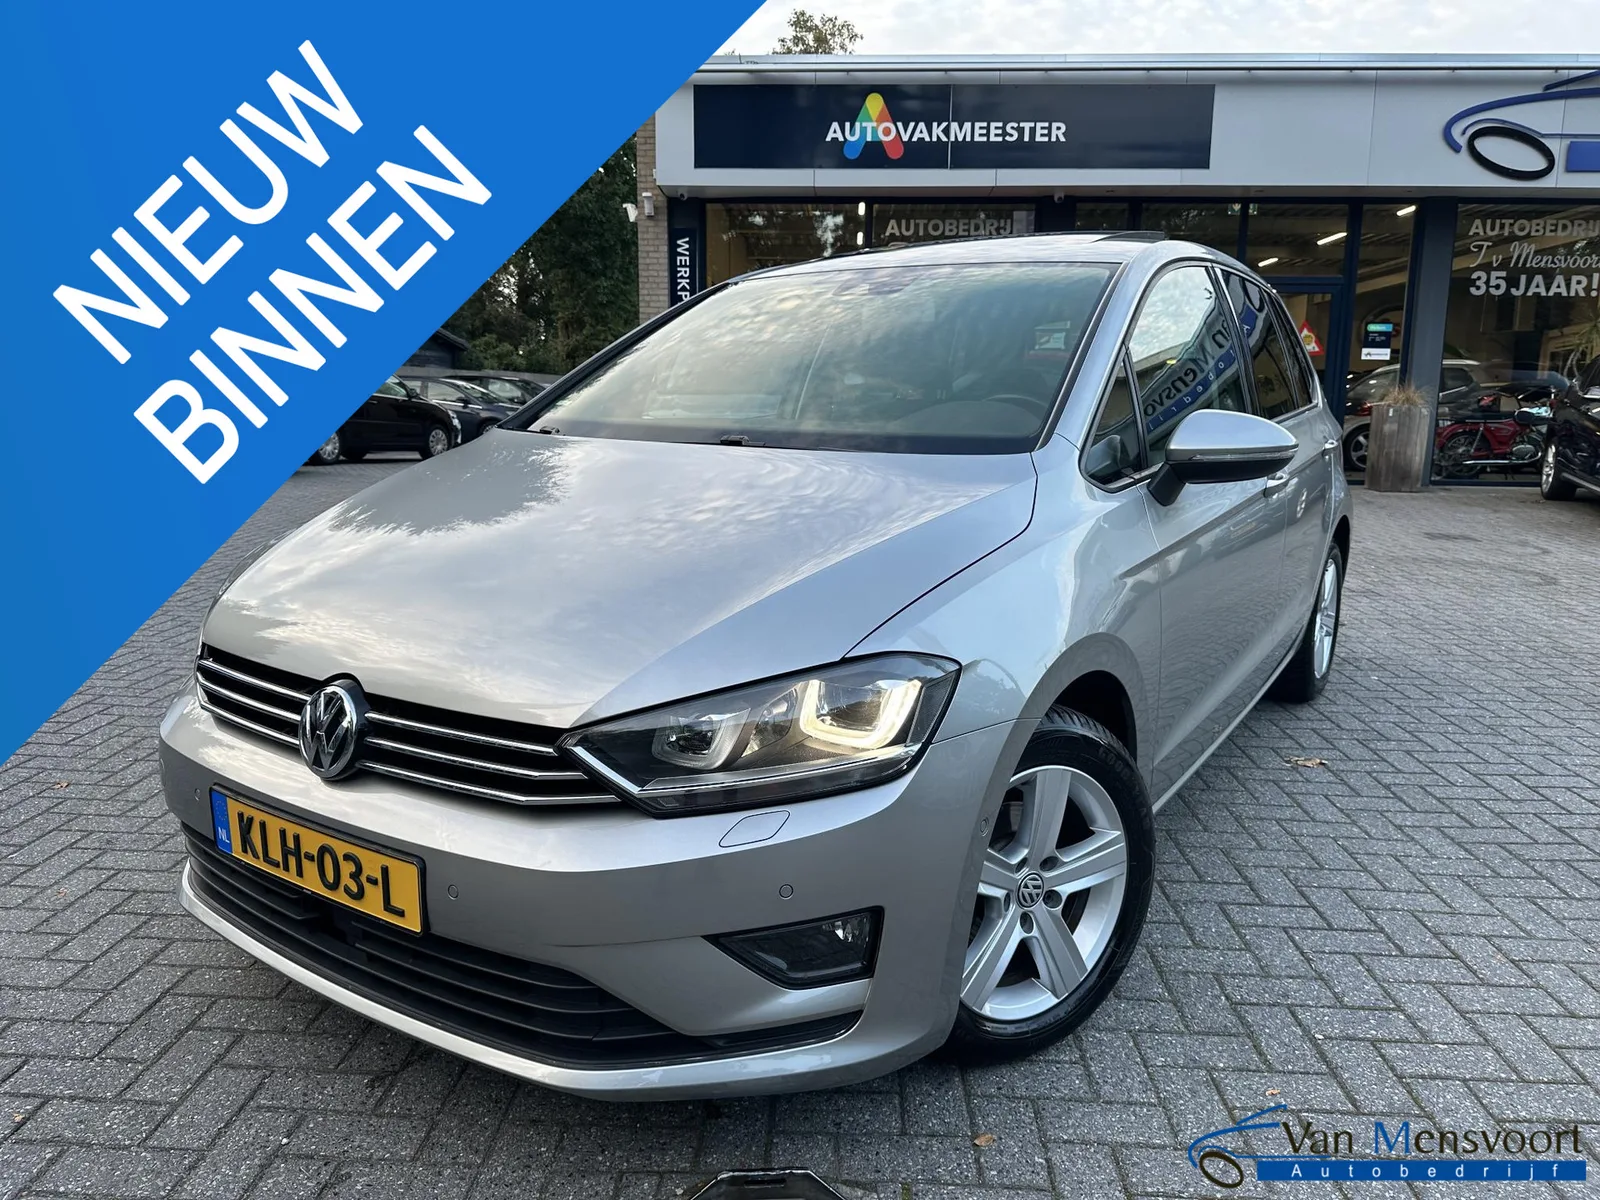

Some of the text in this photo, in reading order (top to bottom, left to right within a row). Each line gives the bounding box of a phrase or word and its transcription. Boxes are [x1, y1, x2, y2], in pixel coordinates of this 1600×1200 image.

[825, 121, 1067, 142] AUTOVAKMEESTER
[1510, 241, 1600, 268] Mensvoor
[676, 237, 690, 304] WERKP
[1469, 270, 1600, 297] 35 JAAR!
[218, 826, 230, 843] NL
[237, 810, 405, 917] KLH-03-L
